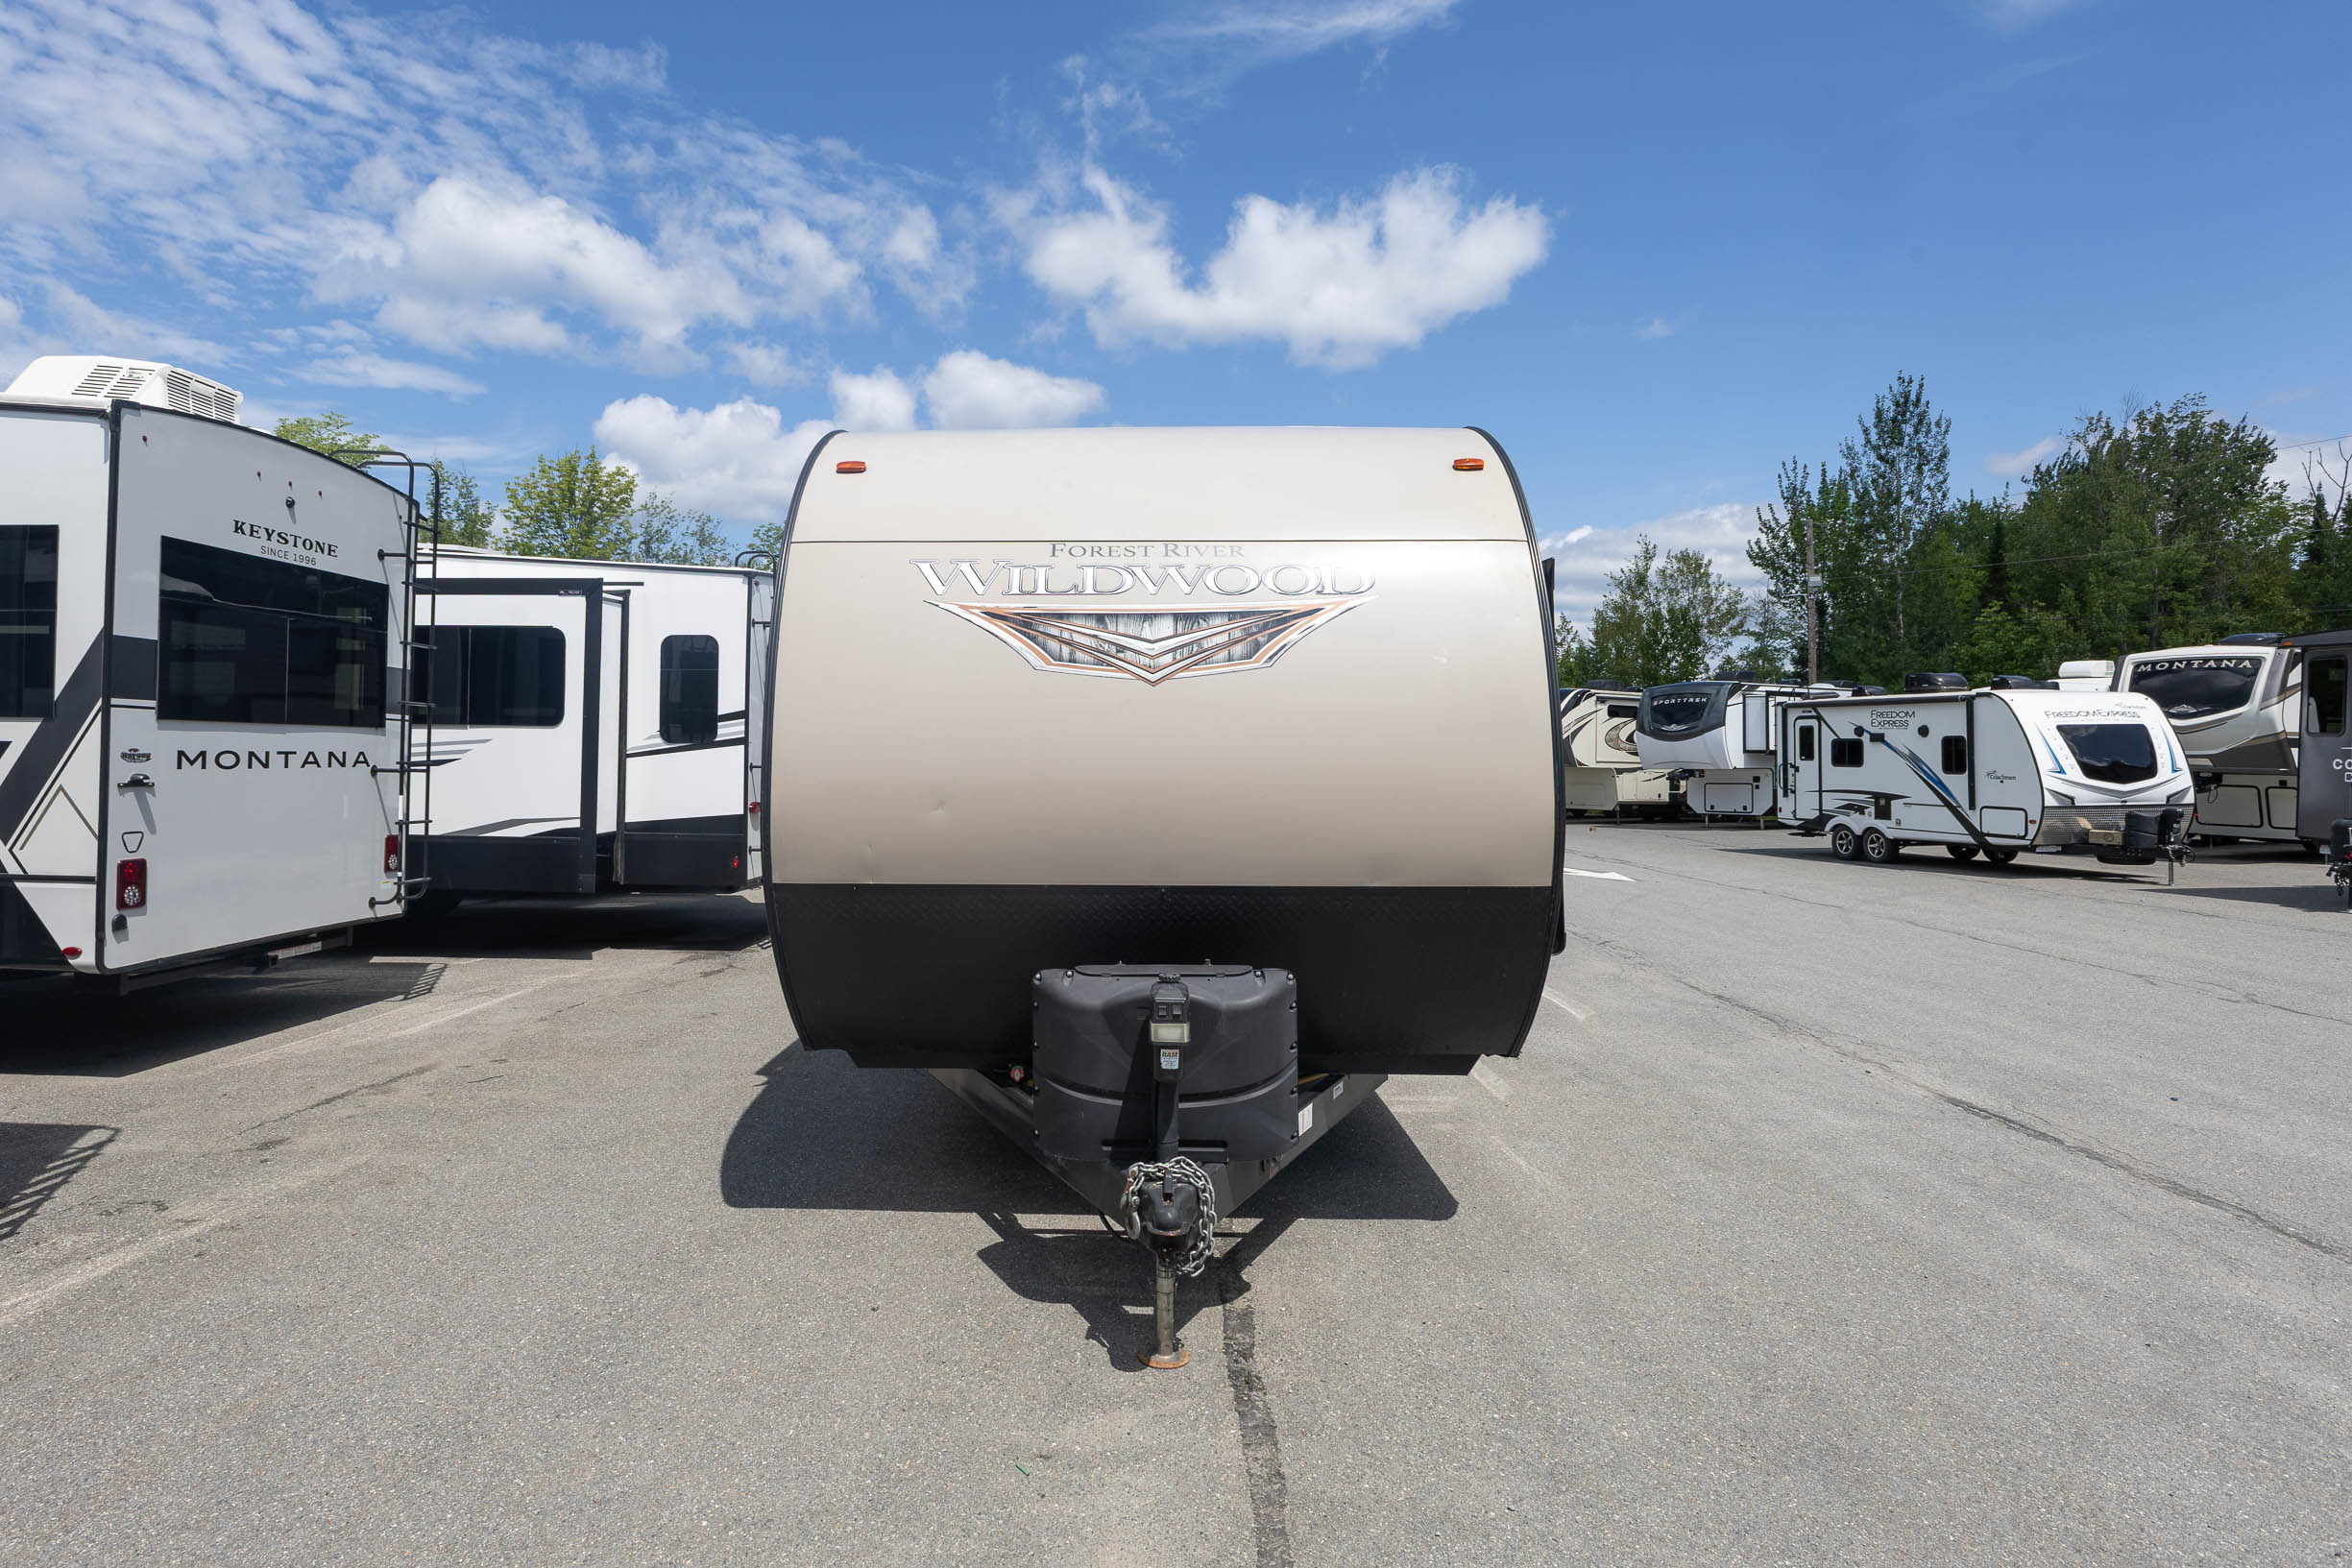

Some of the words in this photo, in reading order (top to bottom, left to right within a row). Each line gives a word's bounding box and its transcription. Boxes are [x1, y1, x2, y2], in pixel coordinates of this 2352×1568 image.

[232, 519, 339, 558] KEYSTONE
[260, 545, 289, 560] SINCE
[293, 553, 317, 567] 1996
[1049, 543, 1155, 558] FOREST
[1161, 543, 1245, 558] RIVER
[909, 559, 1375, 595] WILDWOOD
[2137, 660, 2252, 672] MONTANA
[1653, 697, 1708, 706] SPORTTREK
[1871, 710, 1915, 719] FREEDOM
[1871, 719, 1909, 728] EXPRESS
[176, 750, 371, 770] MONTANA
